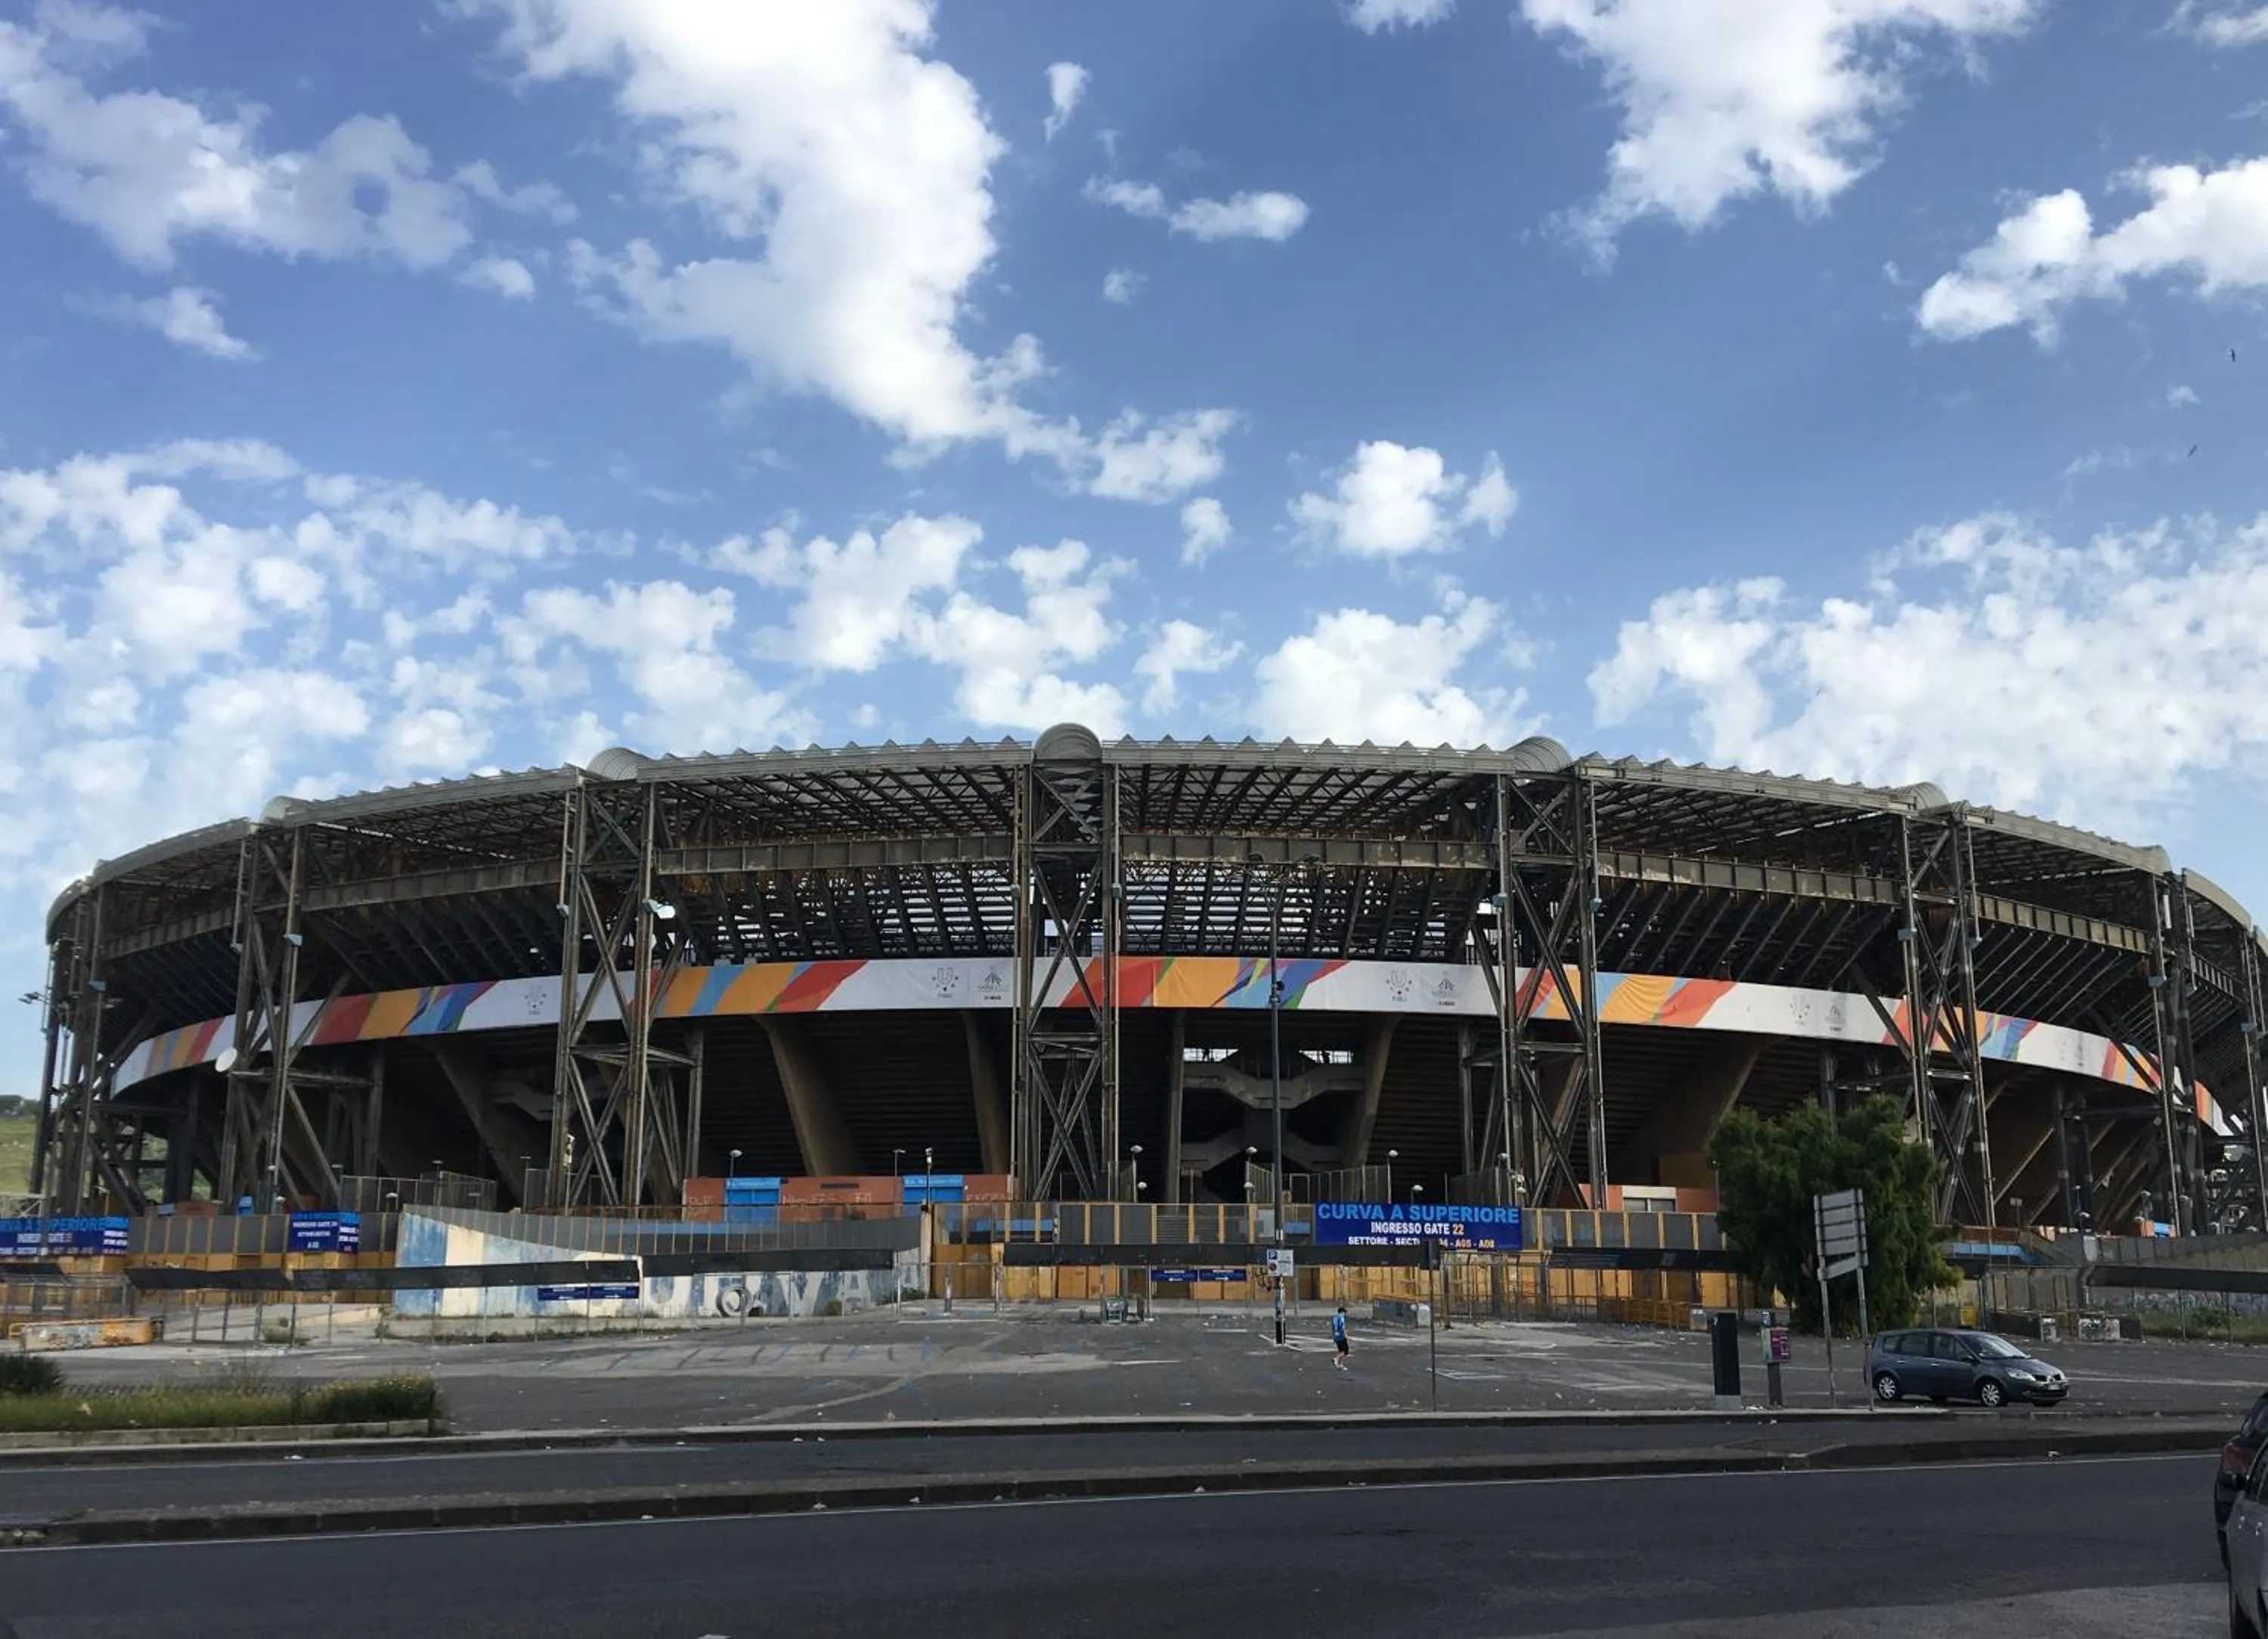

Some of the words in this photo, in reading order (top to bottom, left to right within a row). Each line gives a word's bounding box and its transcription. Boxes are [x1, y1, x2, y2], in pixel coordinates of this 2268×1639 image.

[1318, 1203, 1385, 1219] CURVA
[1390, 1204, 1404, 1220] A
[1408, 1205, 1519, 1224] SUPERIORE
[1371, 1221, 1422, 1234] INGRESSO
[1424, 1223, 1450, 1235] GATE
[1452, 1223, 1464, 1235] 22
[1348, 1236, 1389, 1245] SETTORE
